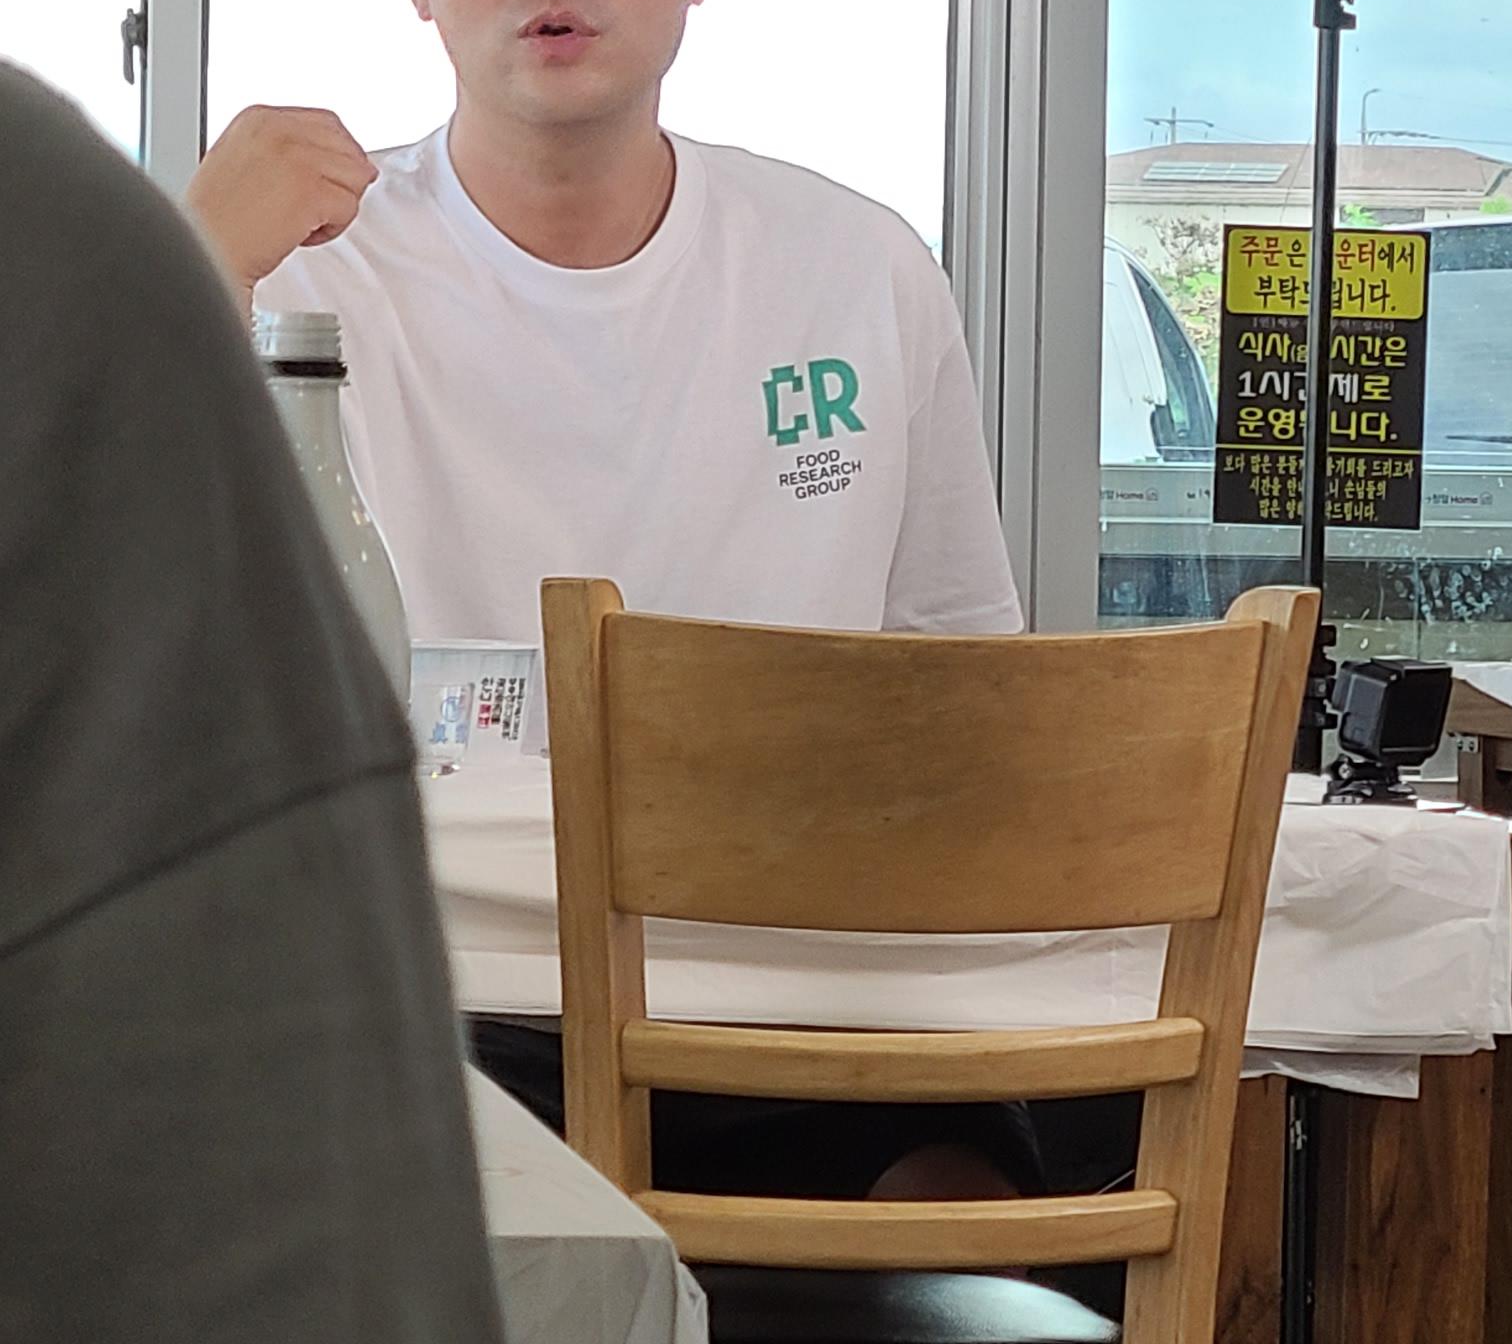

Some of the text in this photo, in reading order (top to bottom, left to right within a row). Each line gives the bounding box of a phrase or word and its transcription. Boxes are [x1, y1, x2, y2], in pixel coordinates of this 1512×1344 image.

[1336, 239, 1415, 274] 운터에서
[1236, 407, 1398, 443] 운영니다.
[797, 449, 840, 469] FOOD
[779, 460, 862, 487] RESEARCH
[795, 477, 851, 499] GROUP
